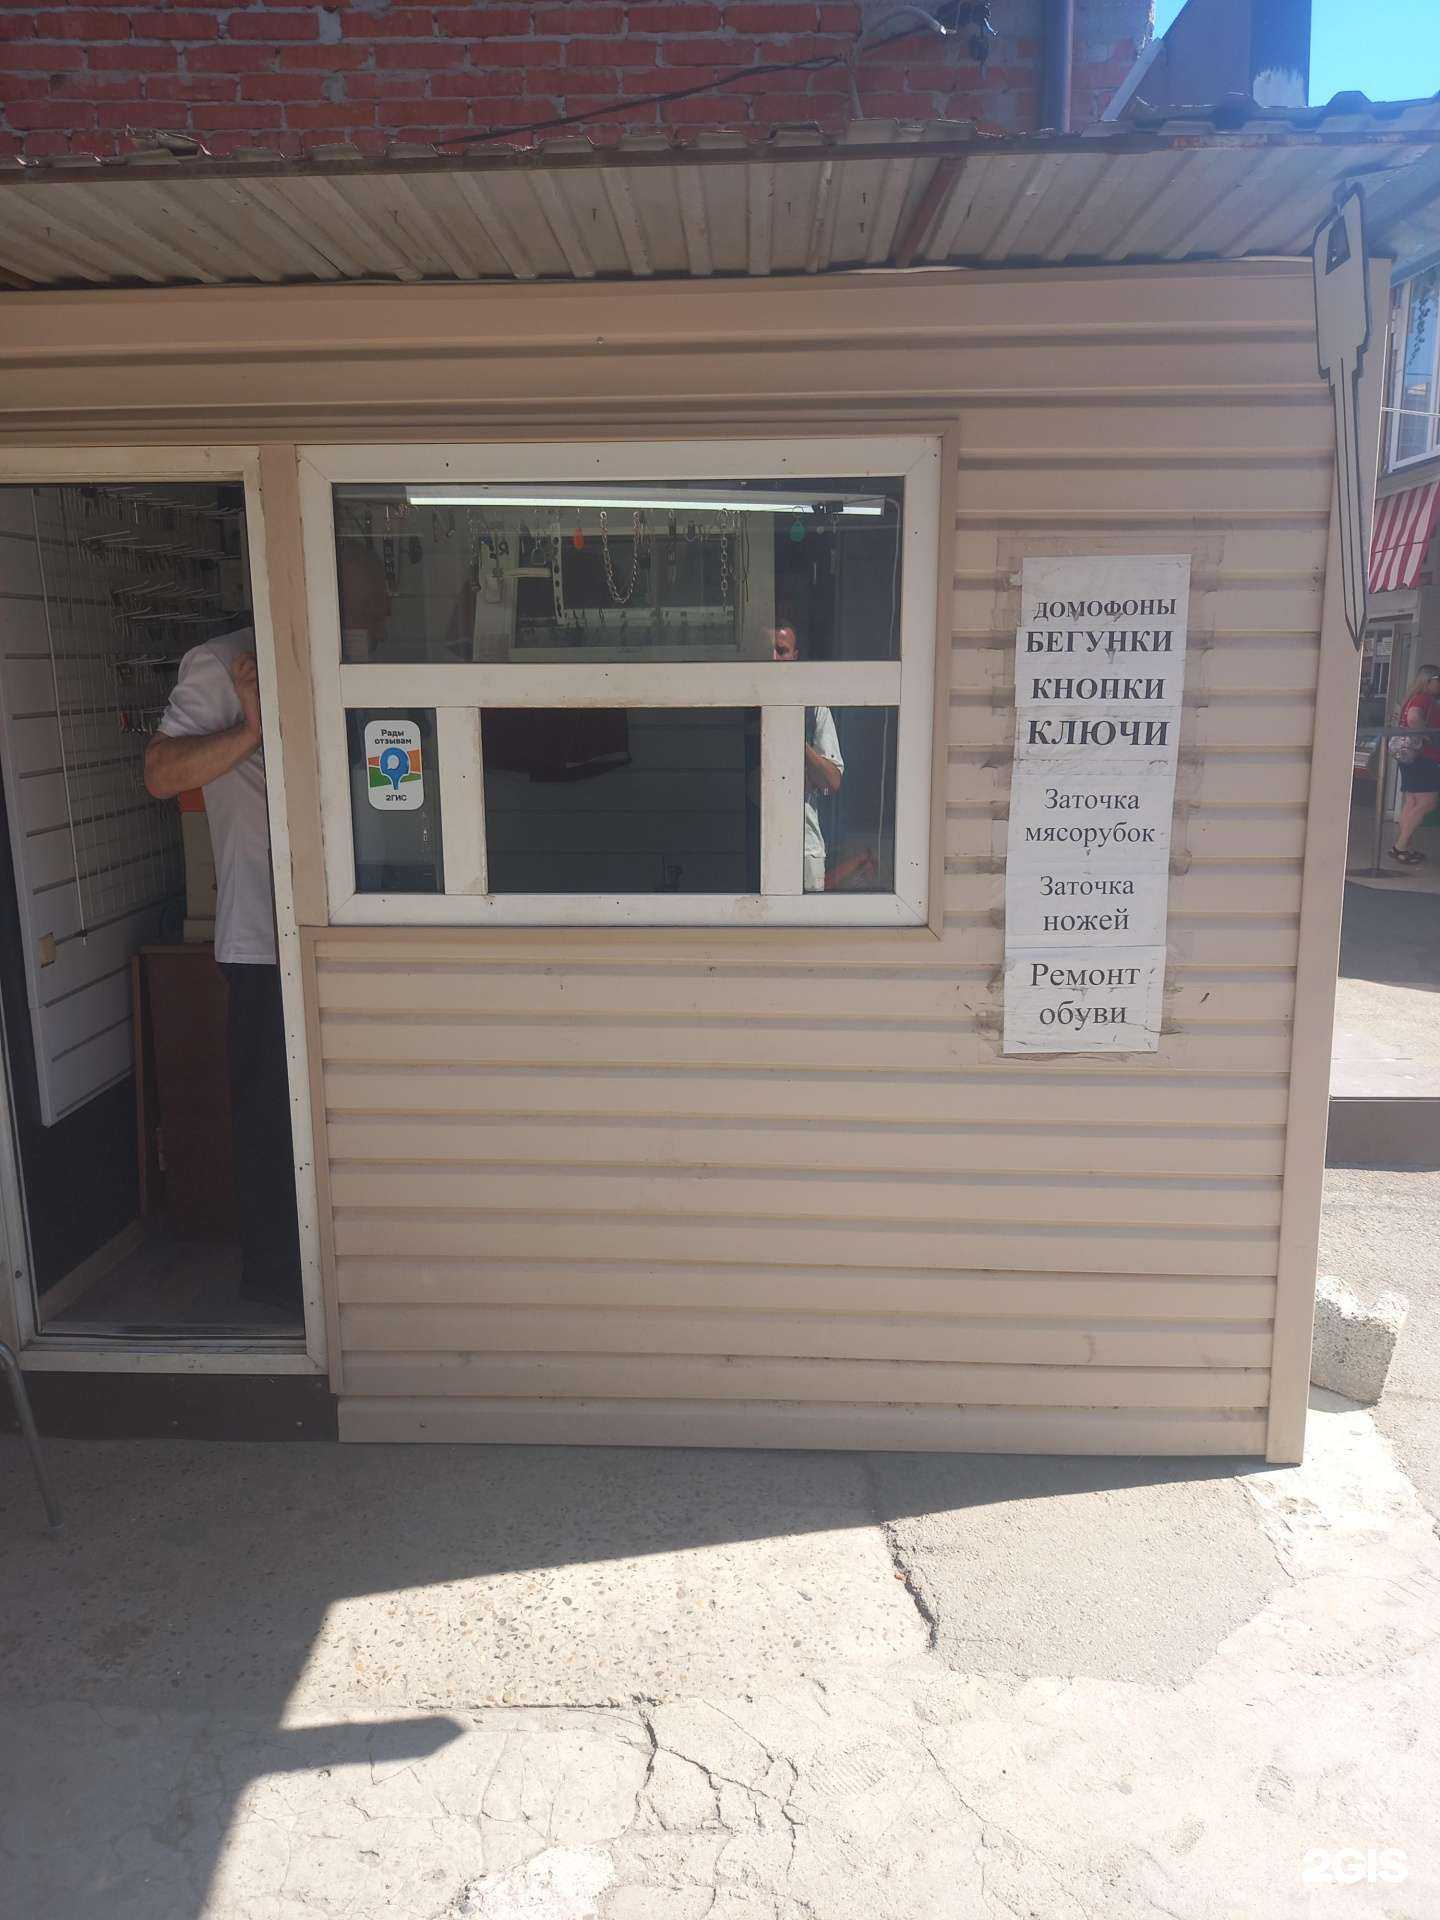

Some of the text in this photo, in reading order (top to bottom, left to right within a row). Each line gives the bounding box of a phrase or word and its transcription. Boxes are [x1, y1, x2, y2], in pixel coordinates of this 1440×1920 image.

[1025, 631, 1172, 653] БЕГУНКИ
[1031, 678, 1166, 700] КНОПКИ
[381, 729, 404, 737] Рады
[1026, 720, 1170, 746] КЛЮЧИ
[1044, 788, 1140, 810] Заточка
[1024, 821, 1155, 848] мясорубок
[1039, 875, 1135, 896] Заточка
[1043, 908, 1130, 931] ножей
[1030, 963, 1141, 987] Ремонт
[1039, 1000, 1127, 1031] обуви
